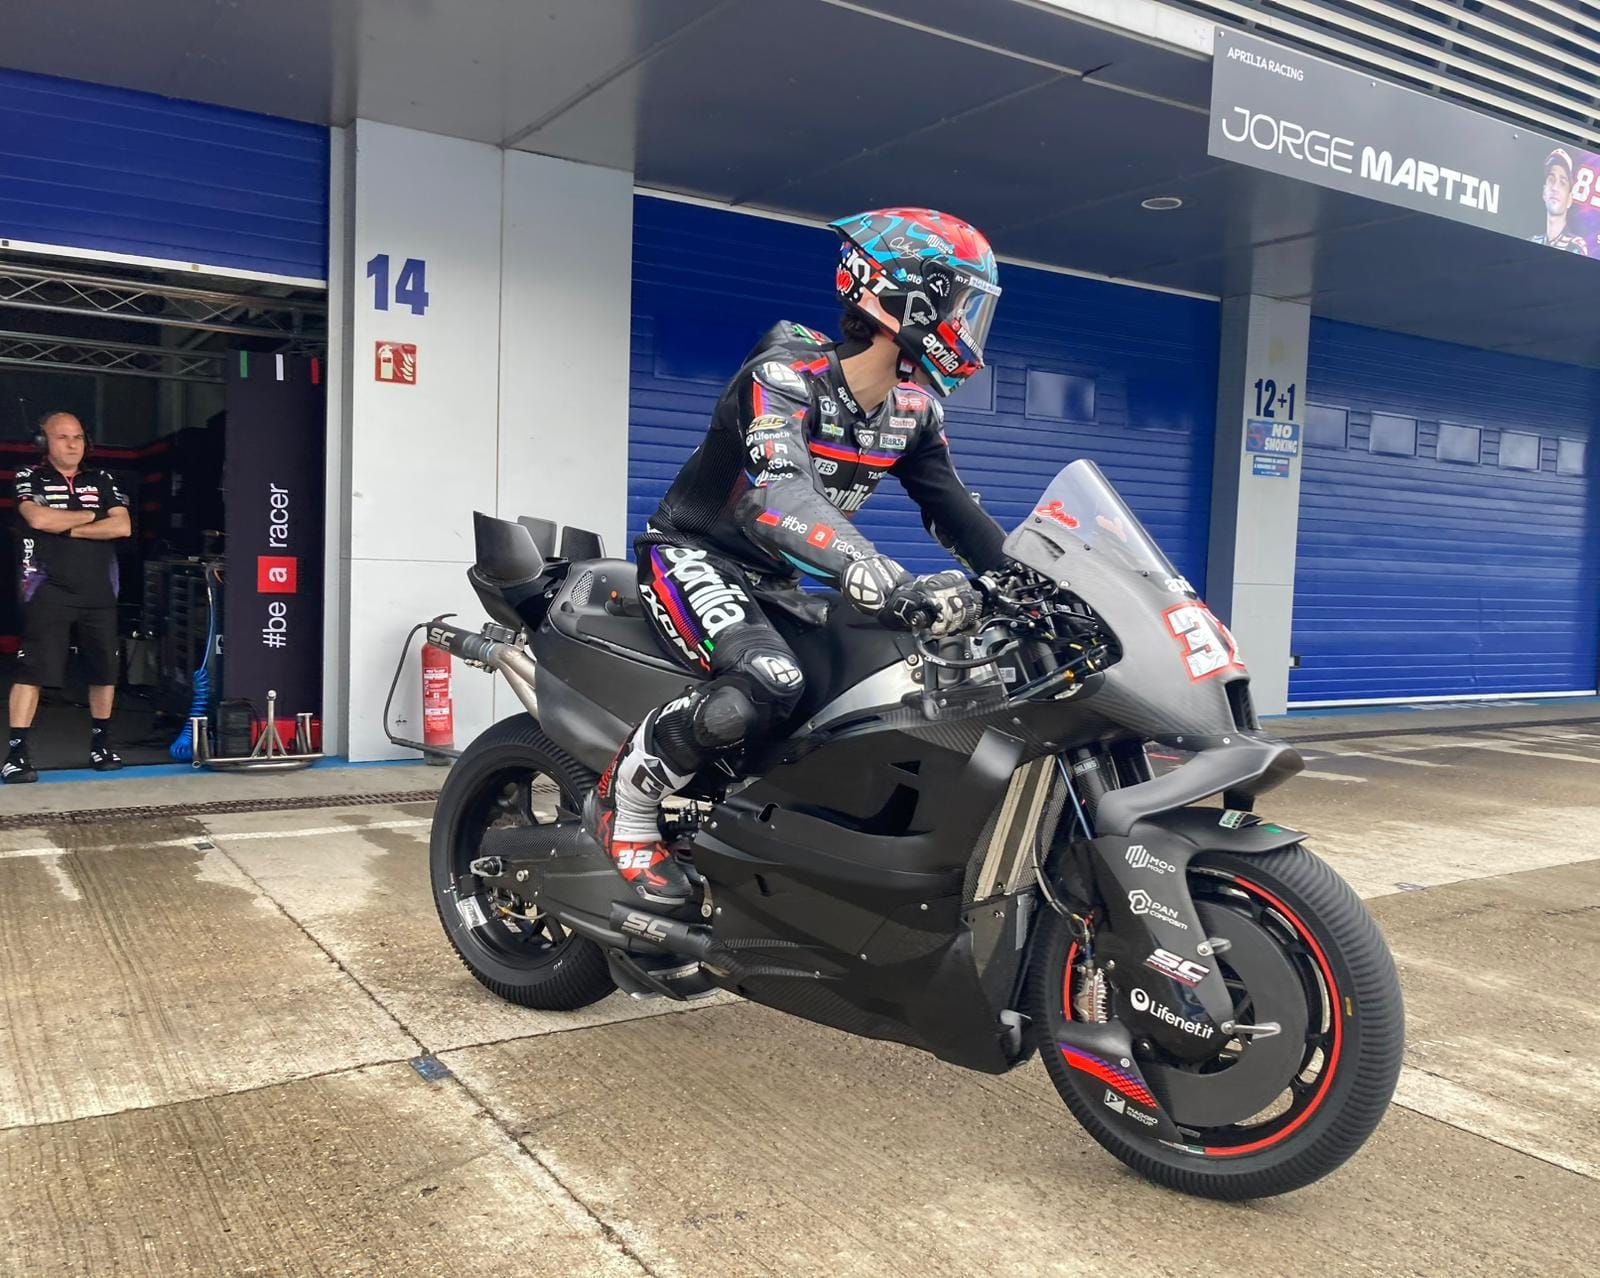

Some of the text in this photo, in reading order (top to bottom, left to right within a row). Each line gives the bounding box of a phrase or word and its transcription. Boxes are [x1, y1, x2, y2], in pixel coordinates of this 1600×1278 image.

[1226, 47, 1304, 81] APRILIA RACING
[1222, 106, 1500, 214] JORGE MARTIN
[366, 253, 429, 316] 14
[922, 333, 959, 373] aprilia
[1254, 378, 1296, 420] 12+1
[1264, 437, 1298, 453] SMOKING
[1271, 424, 1293, 439] NO
[824, 484, 873, 511] prili
[781, 515, 808, 534] #be
[814, 530, 825, 542] a
[262, 483, 289, 648] #be a racer
[664, 546, 750, 639] aprilia
[428, 627, 457, 647] SC
[639, 583, 700, 660] IXON
[617, 850, 652, 870] 32
[1149, 856, 1176, 873] MOD
[623, 912, 673, 938] SC
[1152, 902, 1179, 919] PAN
[1149, 948, 1211, 981] SC
[1149, 1000, 1214, 1039] Lifenet.it
